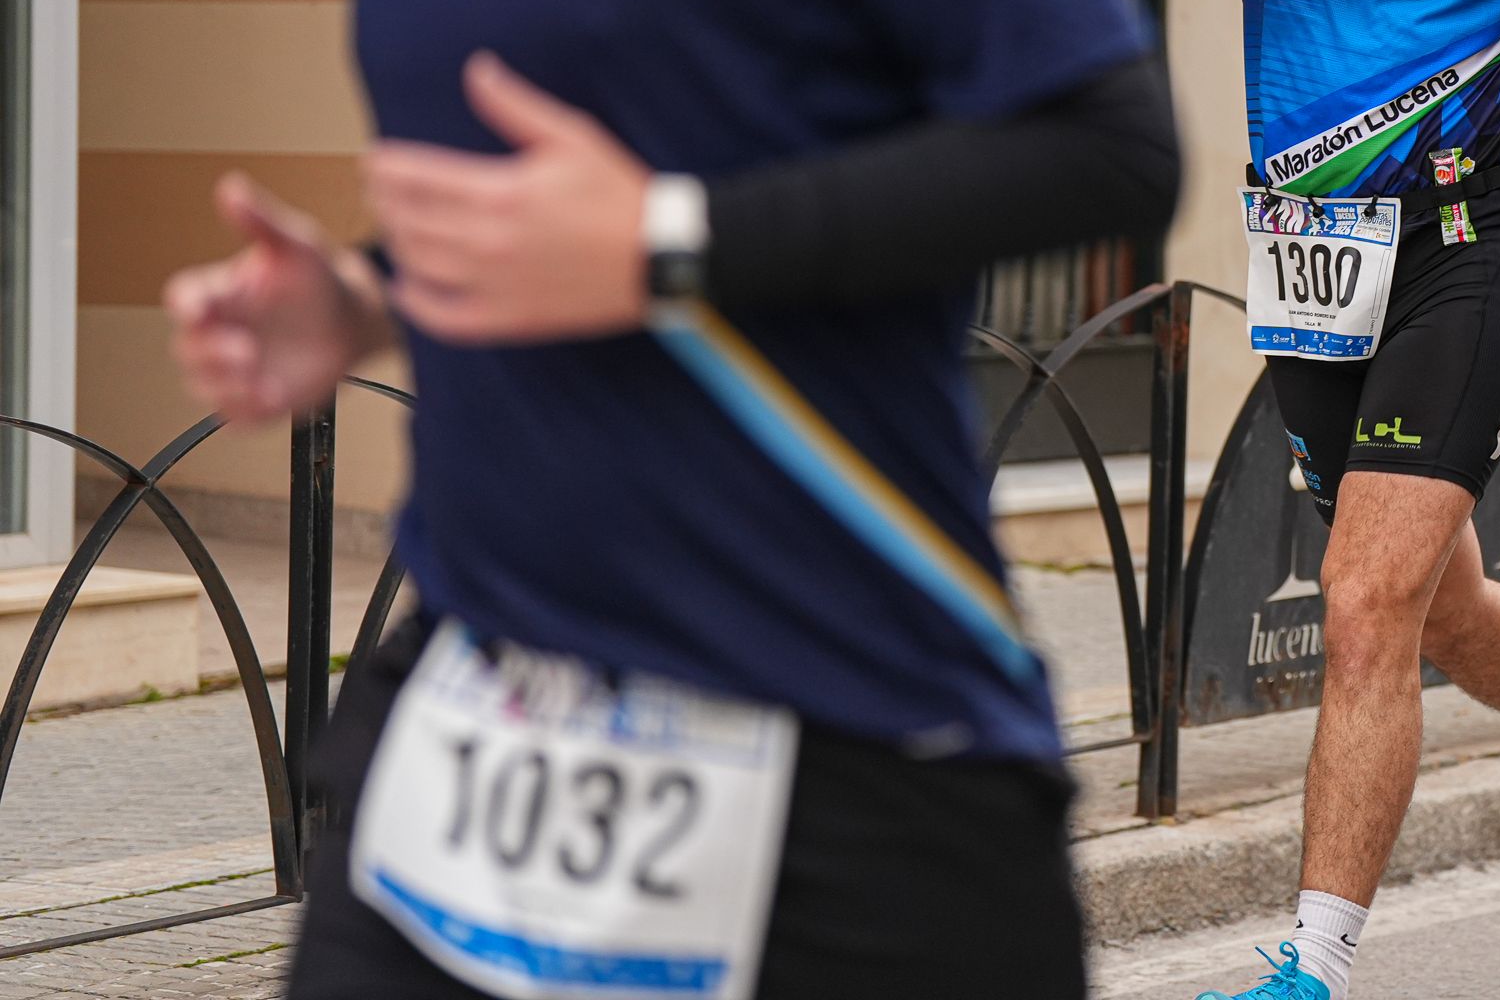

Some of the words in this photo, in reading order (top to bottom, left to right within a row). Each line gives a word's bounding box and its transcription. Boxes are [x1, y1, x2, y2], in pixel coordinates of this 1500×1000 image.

[1270, 124, 1363, 183] Maratón
[1363, 67, 1461, 133] Lucena
[1267, 240, 1362, 309] 1300
[1247, 611, 1324, 666] lucen
[444, 732, 703, 900] 1032
